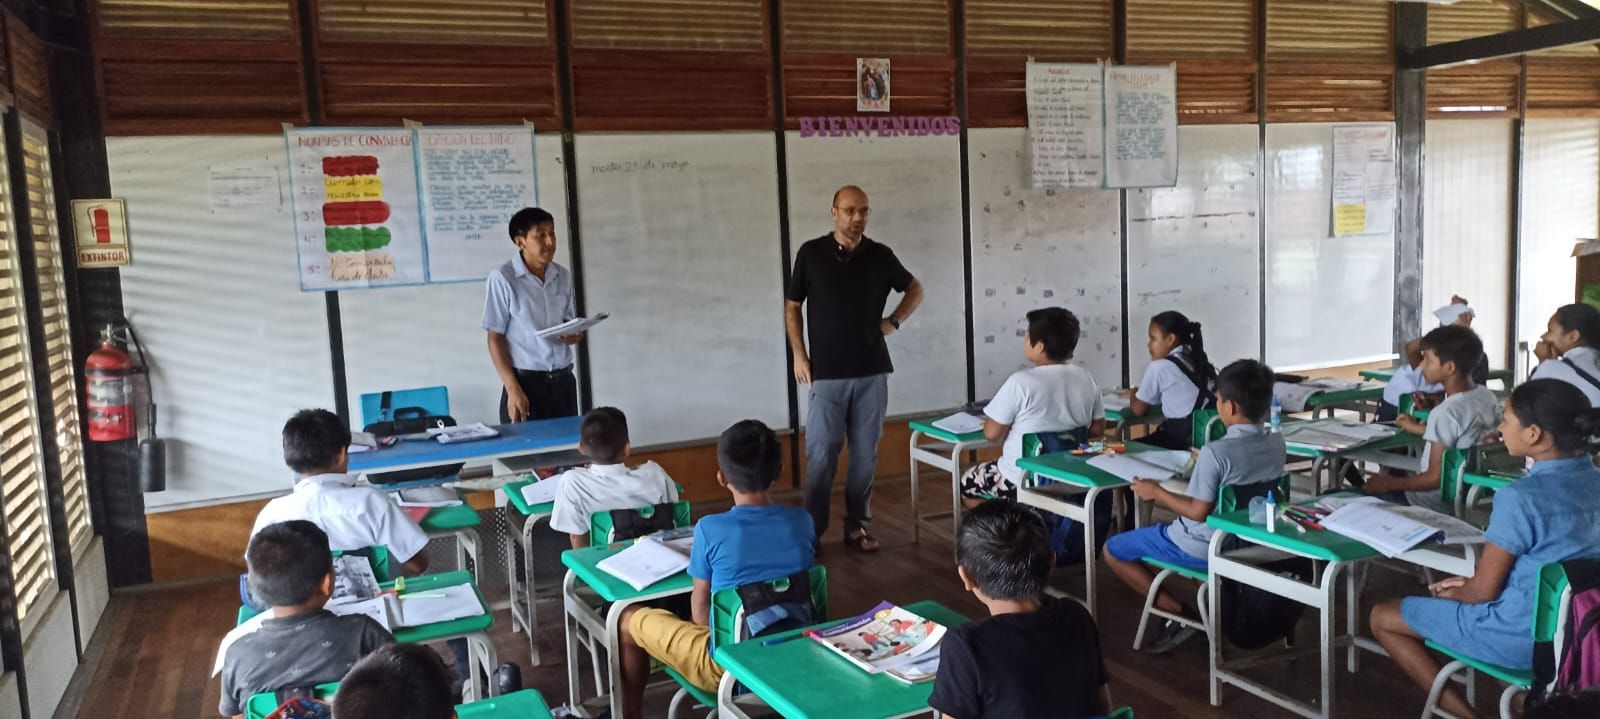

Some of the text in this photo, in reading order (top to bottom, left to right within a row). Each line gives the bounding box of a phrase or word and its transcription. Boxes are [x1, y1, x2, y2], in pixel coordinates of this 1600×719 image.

[799, 116, 961, 138] BIENVENIDOS
[298, 136, 341, 147] NORMAS
[343, 135, 354, 146] DE
[81, 251, 125, 263] EXTINTOR
